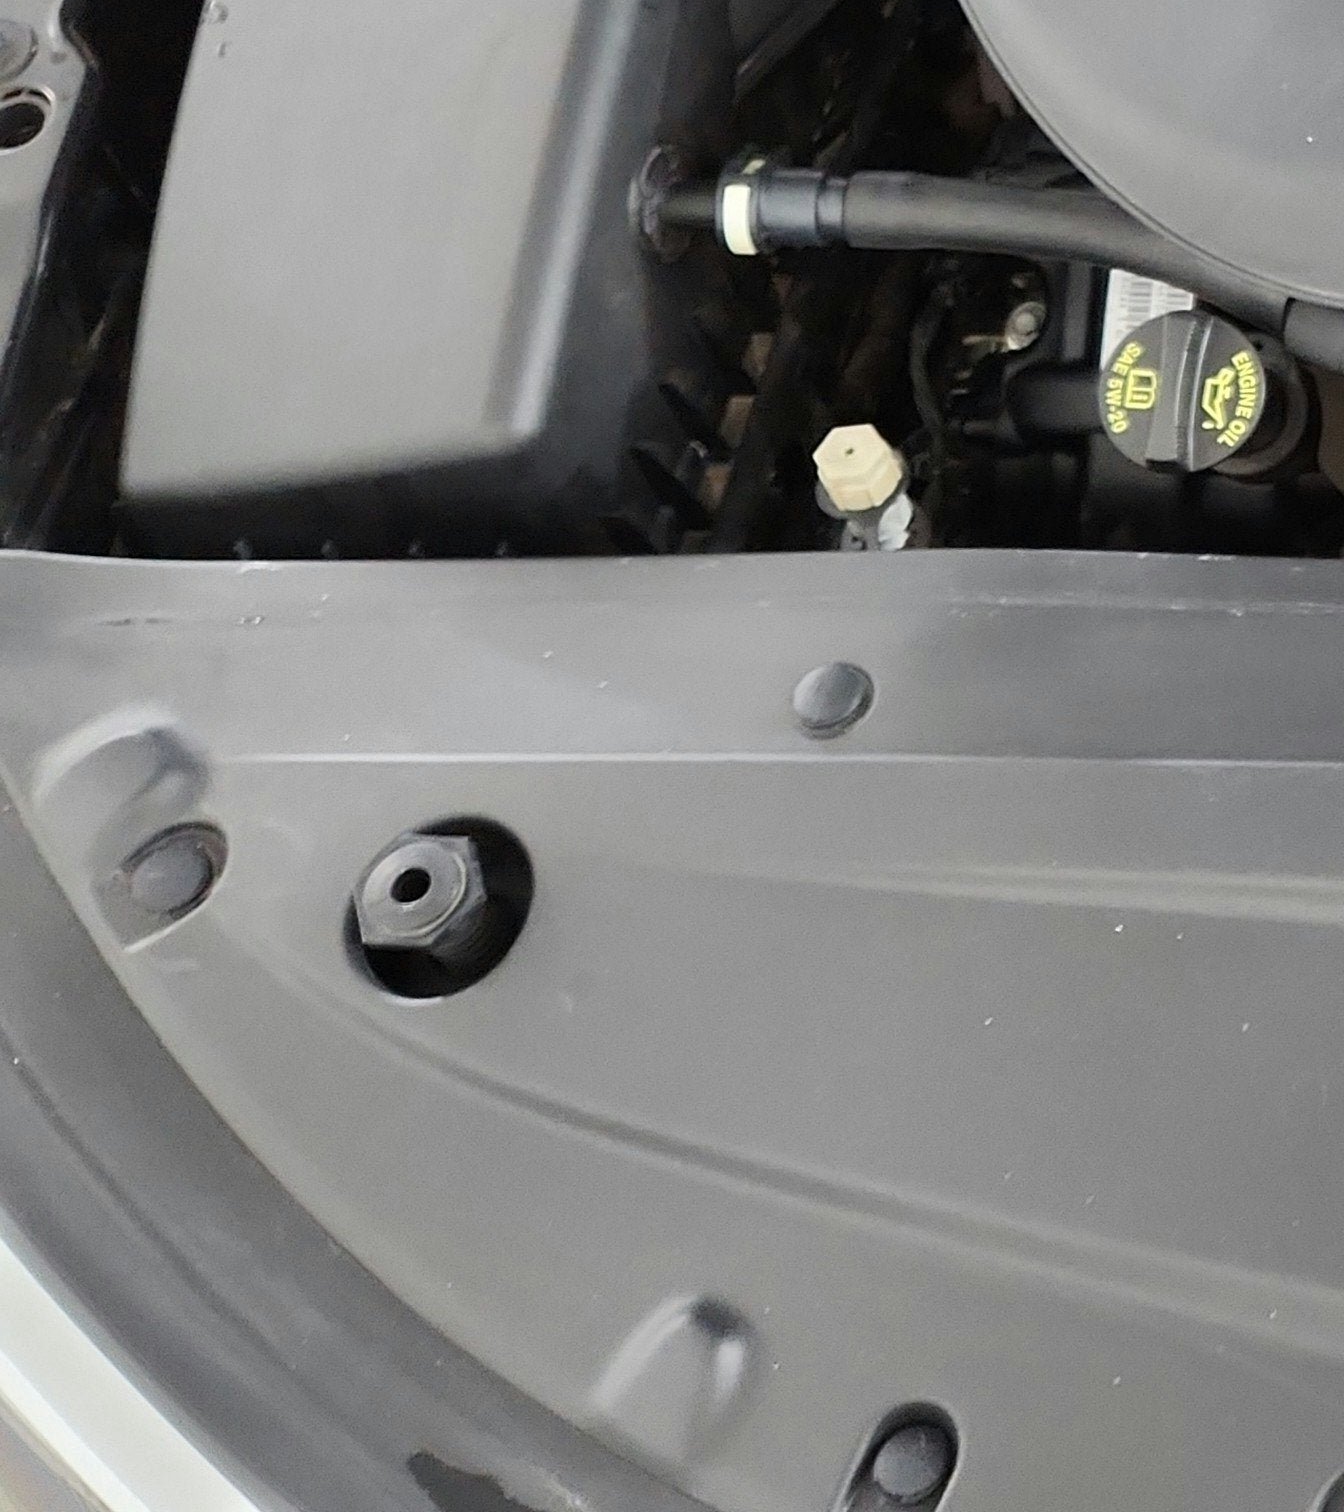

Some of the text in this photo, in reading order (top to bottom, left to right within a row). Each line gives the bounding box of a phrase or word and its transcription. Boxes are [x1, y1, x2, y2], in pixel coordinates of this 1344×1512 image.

[1112, 342, 1142, 376] SAE
[1216, 350, 1257, 448] ENGINE OIL
